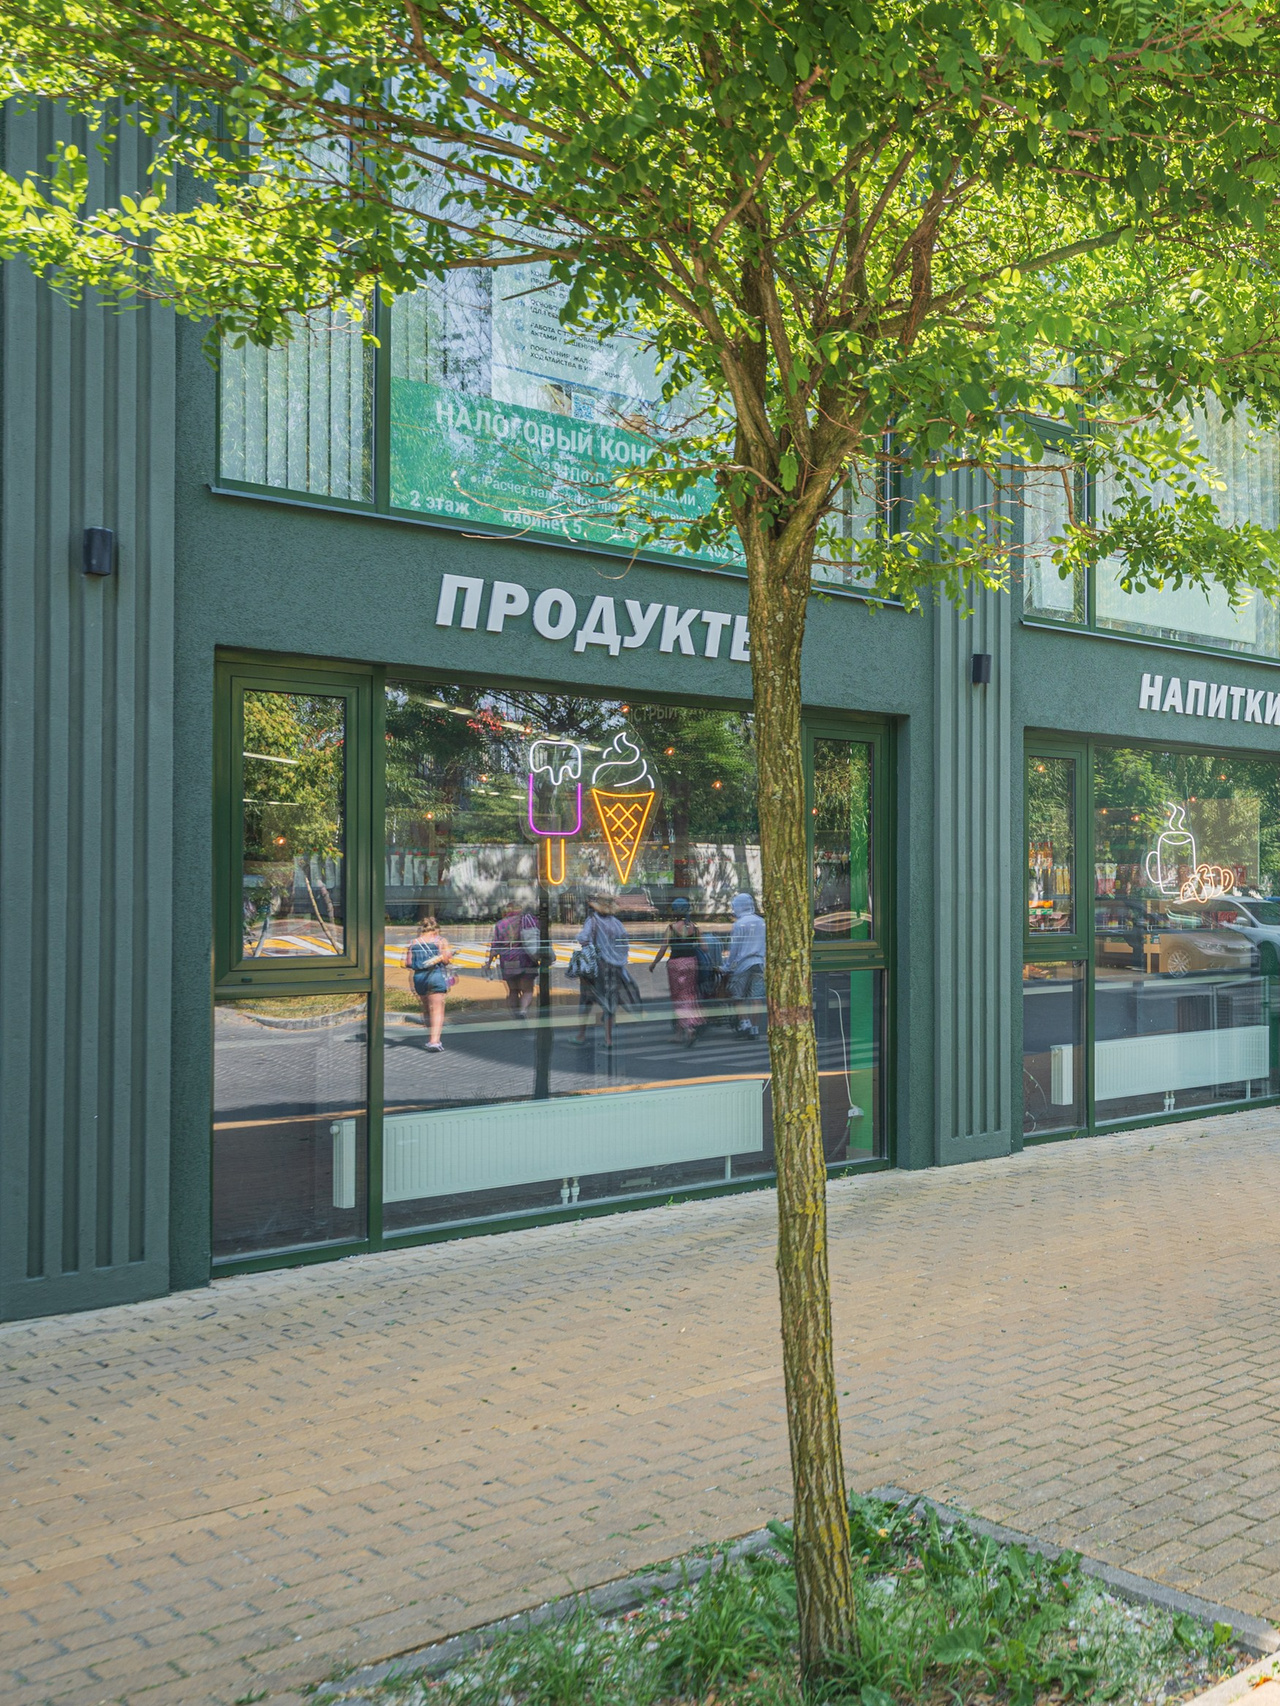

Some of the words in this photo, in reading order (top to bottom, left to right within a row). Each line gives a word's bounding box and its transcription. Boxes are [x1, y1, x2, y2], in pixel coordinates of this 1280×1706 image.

[436, 401, 594, 456] НАЛОГОВЫЙ
[409, 489, 421, 507] 2
[426, 493, 470, 515] этаж
[573, 521, 583, 535] 5
